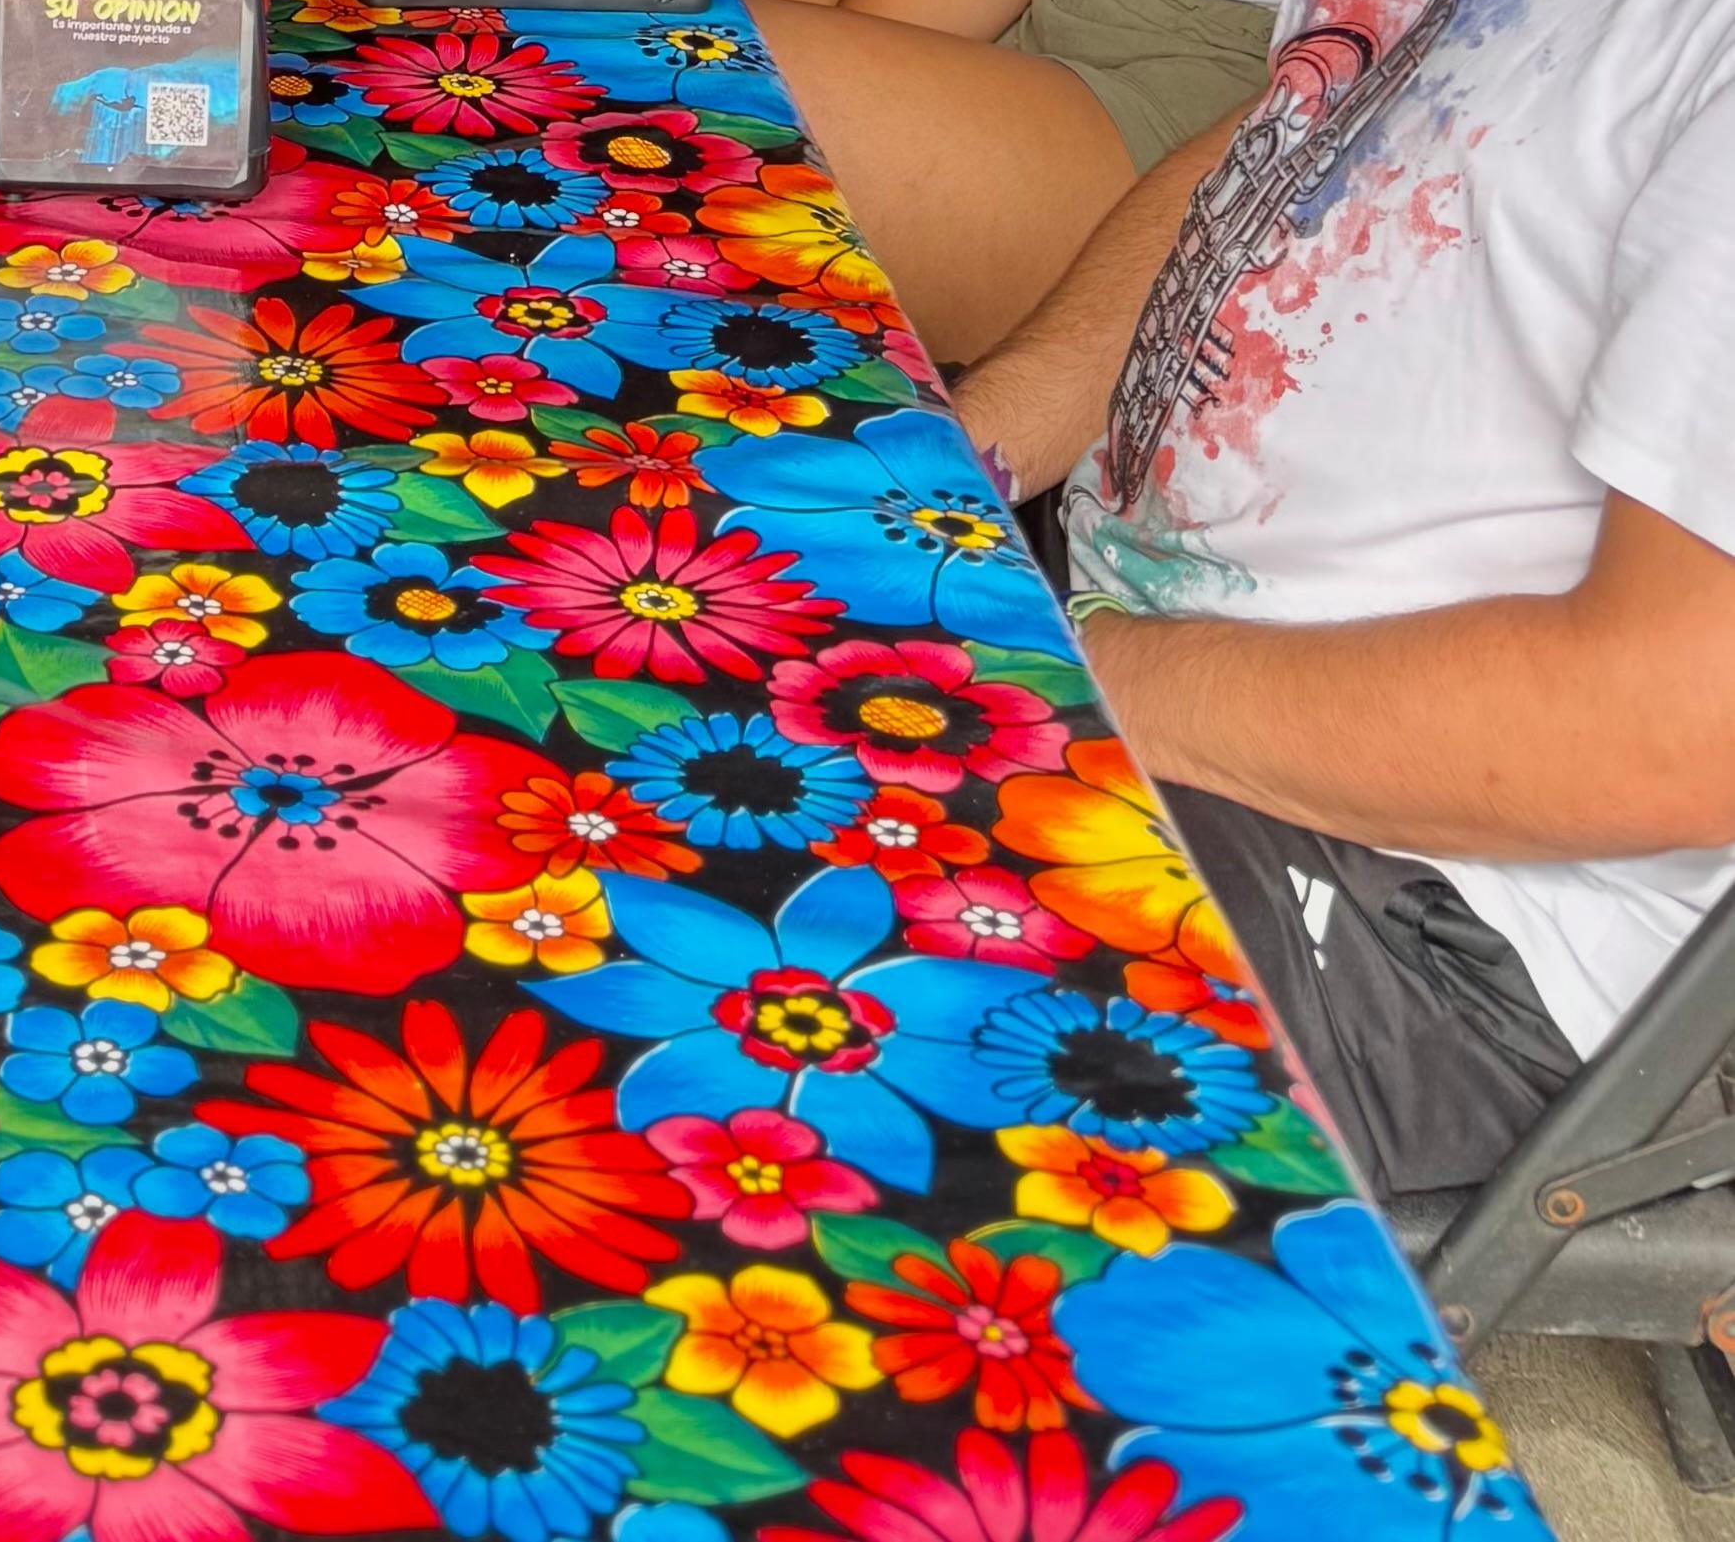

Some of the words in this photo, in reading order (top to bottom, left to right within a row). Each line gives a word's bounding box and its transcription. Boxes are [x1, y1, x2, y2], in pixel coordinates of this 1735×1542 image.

[67, 18, 133, 33] importante
[142, 22, 182, 35] ayuda
[72, 31, 117, 42] nuestro
[118, 33, 170, 47] proyecto
